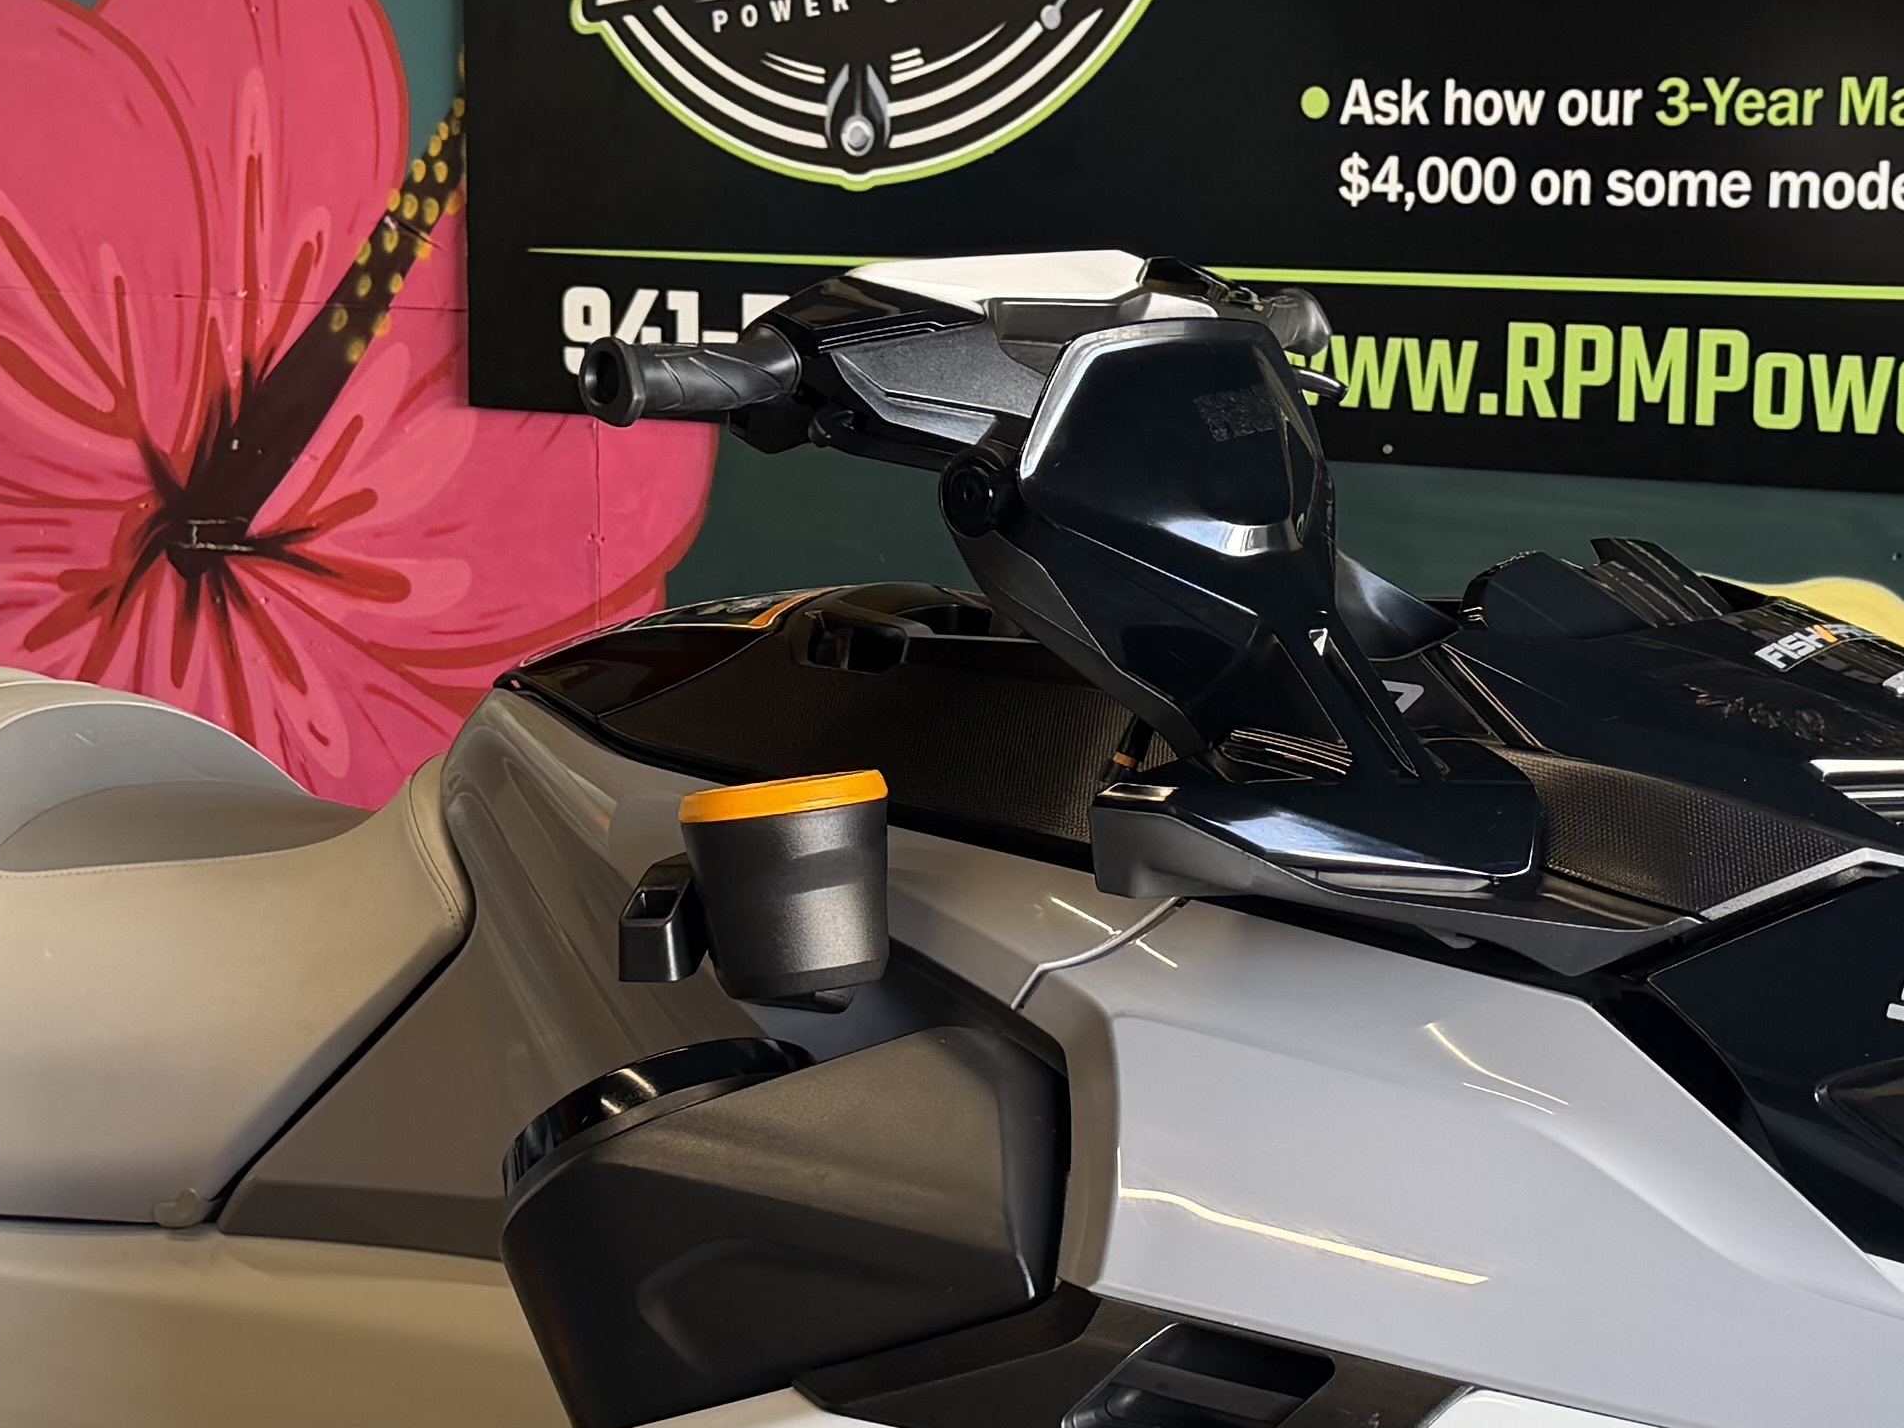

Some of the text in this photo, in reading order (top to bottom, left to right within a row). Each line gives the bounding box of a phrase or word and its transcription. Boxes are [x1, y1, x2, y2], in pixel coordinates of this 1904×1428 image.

[1339, 78, 1430, 126] Ask
[1444, 78, 1546, 126] how
[1557, 88, 1643, 127] our
[1655, 77, 1824, 127] 3-Year
[1338, 151, 1517, 212] $4,000
[1530, 168, 1591, 206] on
[1605, 169, 1752, 209] some
